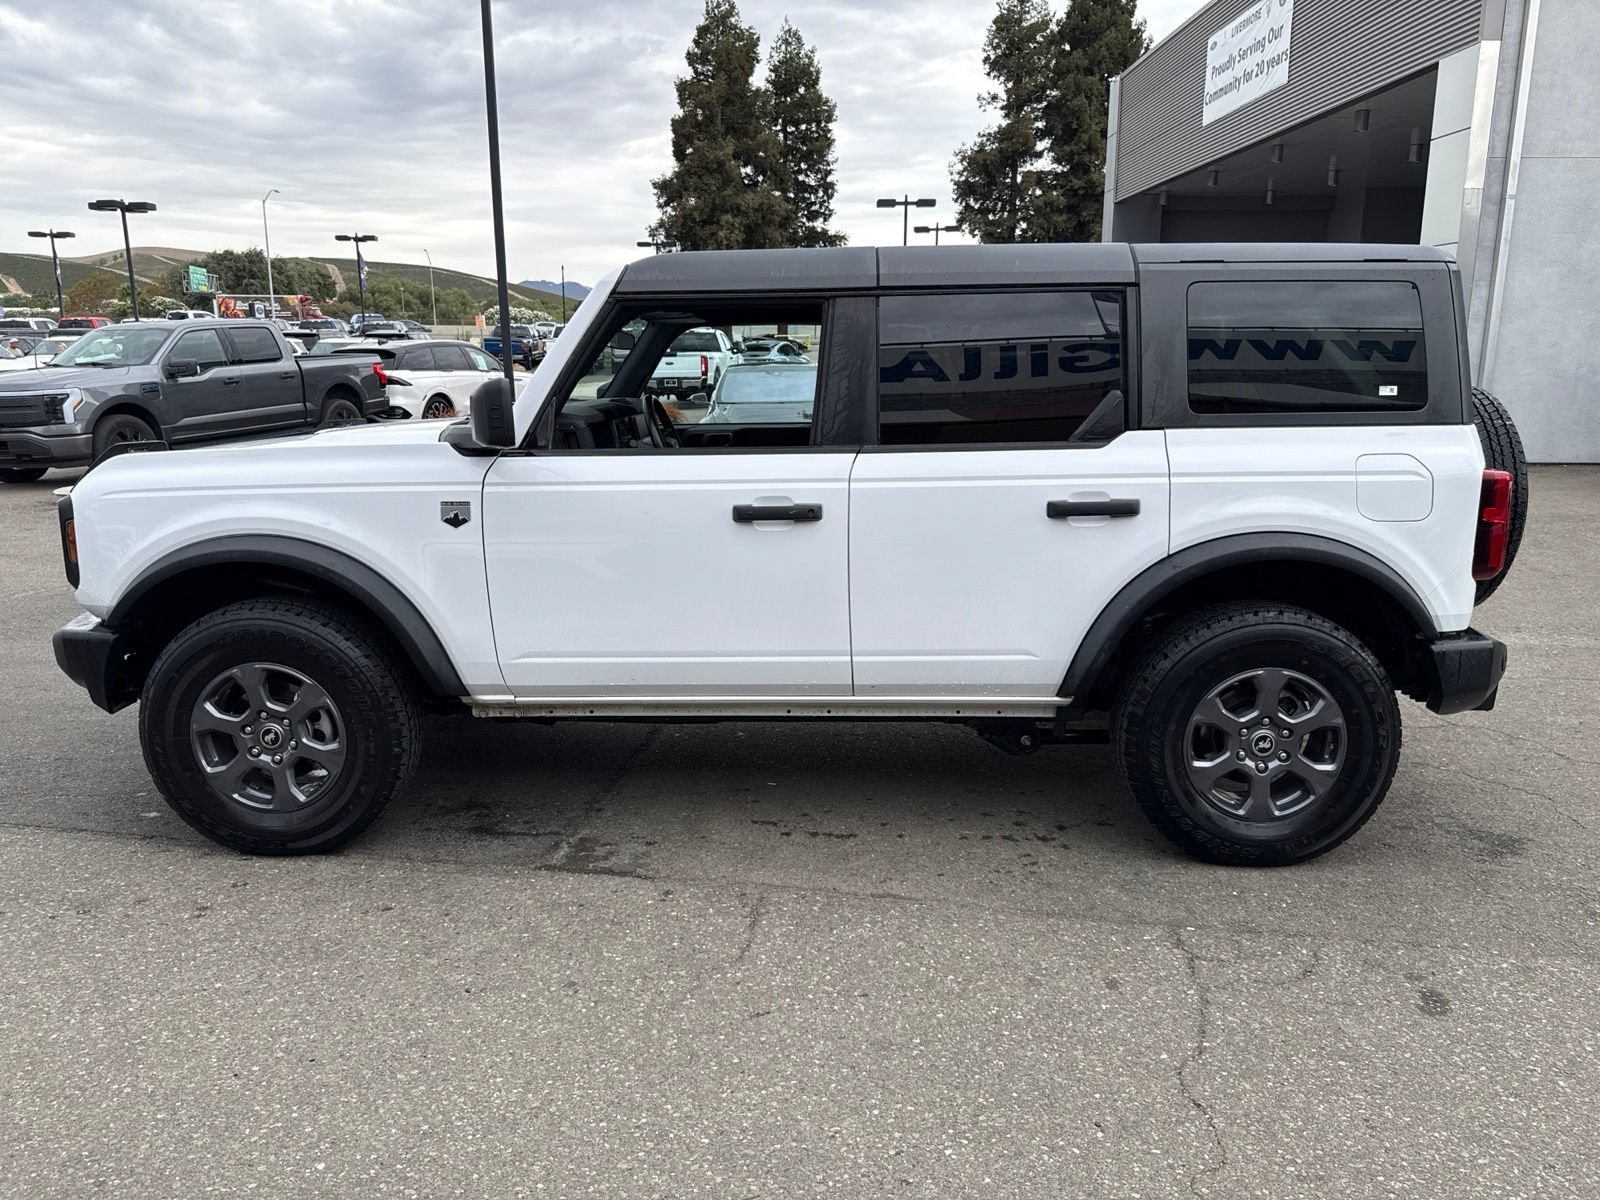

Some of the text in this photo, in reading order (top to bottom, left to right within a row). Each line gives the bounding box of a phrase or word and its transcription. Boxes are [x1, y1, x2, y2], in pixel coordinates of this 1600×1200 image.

[1231, 7, 1263, 38] LIVERMORE
[1204, 48, 1289, 106] Community for 20 years
[1211, 24, 1284, 80] Proudly Serving Our
